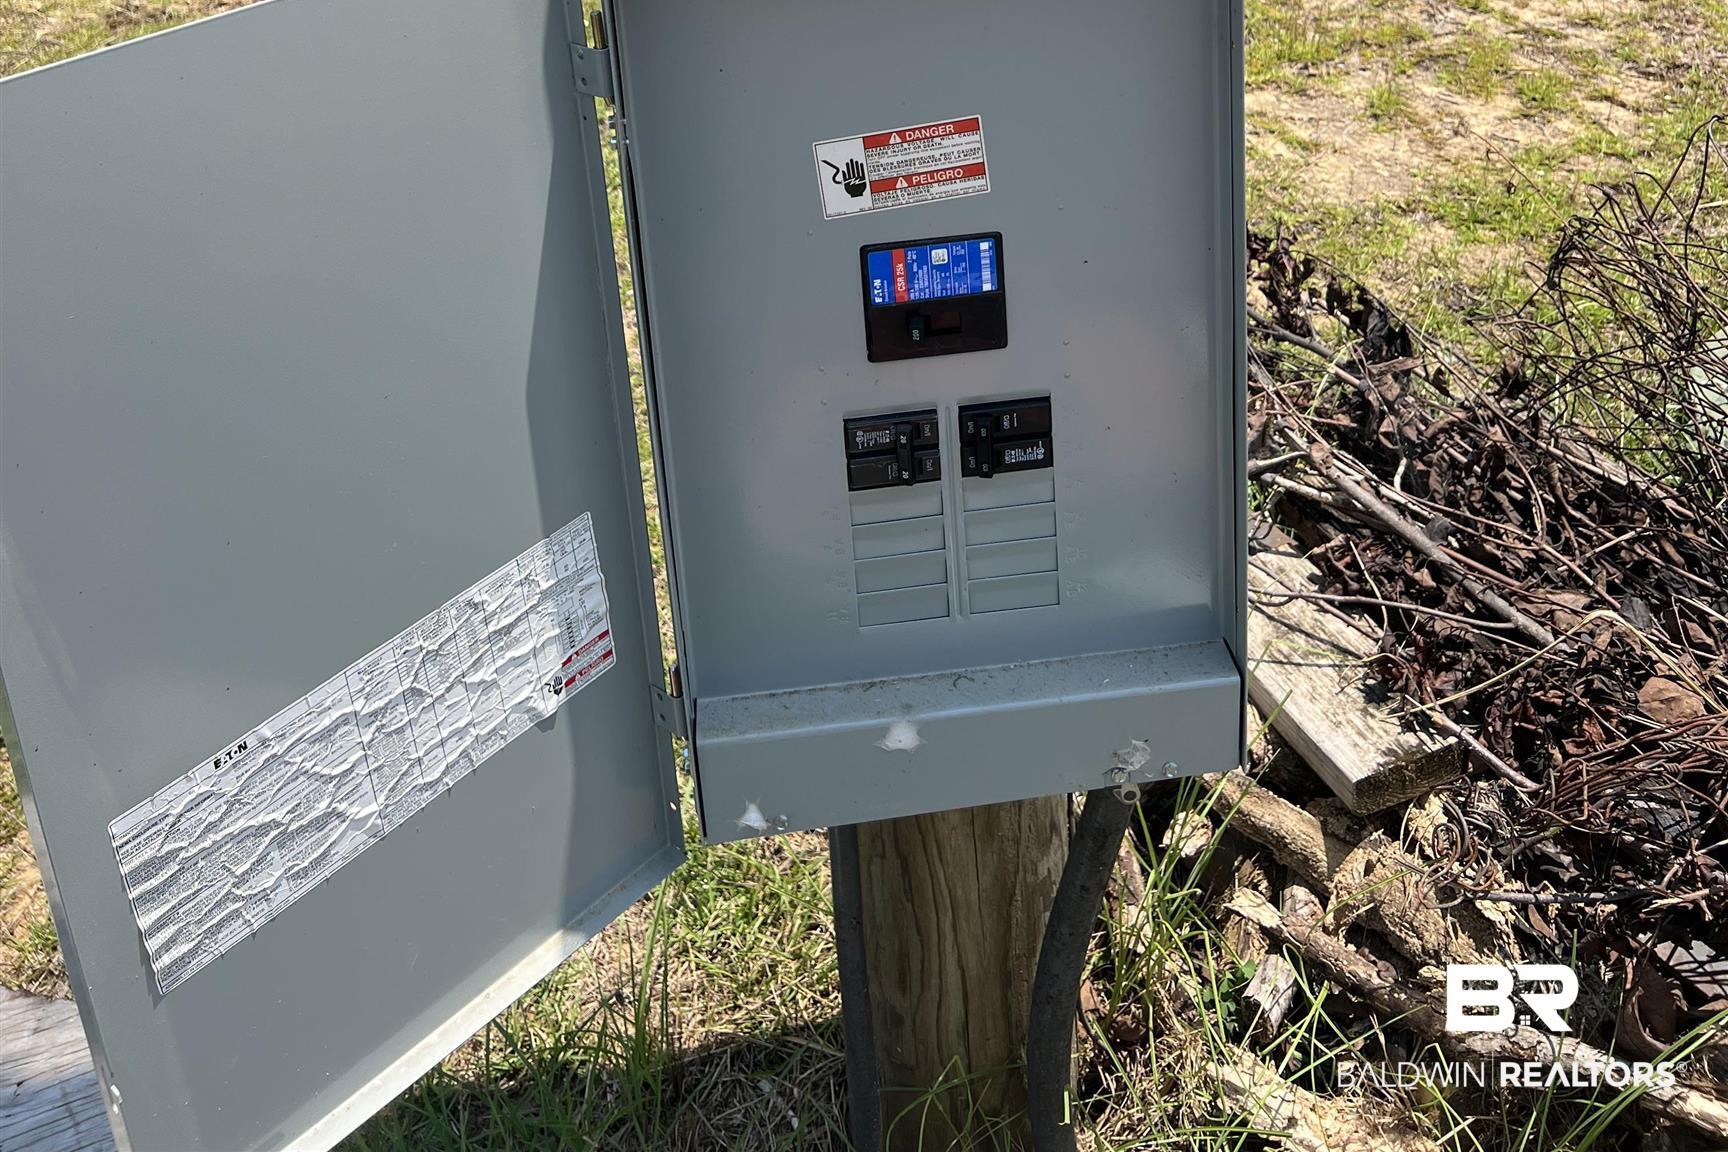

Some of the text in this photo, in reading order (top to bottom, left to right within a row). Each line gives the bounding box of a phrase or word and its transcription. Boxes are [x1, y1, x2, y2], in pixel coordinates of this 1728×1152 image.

[905, 124, 955, 141] DANGER
[866, 143, 904, 154] HAZARDOUS
[958, 131, 979, 139] CAUSE
[868, 162, 895, 170] TENSION
[957, 147, 981, 155] CAUSER
[890, 147, 912, 155] INJURY
[882, 163, 917, 172] BLESSURES
[919, 158, 942, 166] GRAVES
[912, 168, 964, 186] PELIGRO
[872, 190, 898, 198] VOLTAJE
[937, 180, 957, 188] CAUSA
[959, 175, 985, 184] HERIDAS
[873, 194, 900, 202] SEVERAS
[897, 263, 906, 292] CSR 25k
[912, 329, 920, 341] 200
[900, 435, 907, 444] 20
[902, 471, 909, 479] 20
